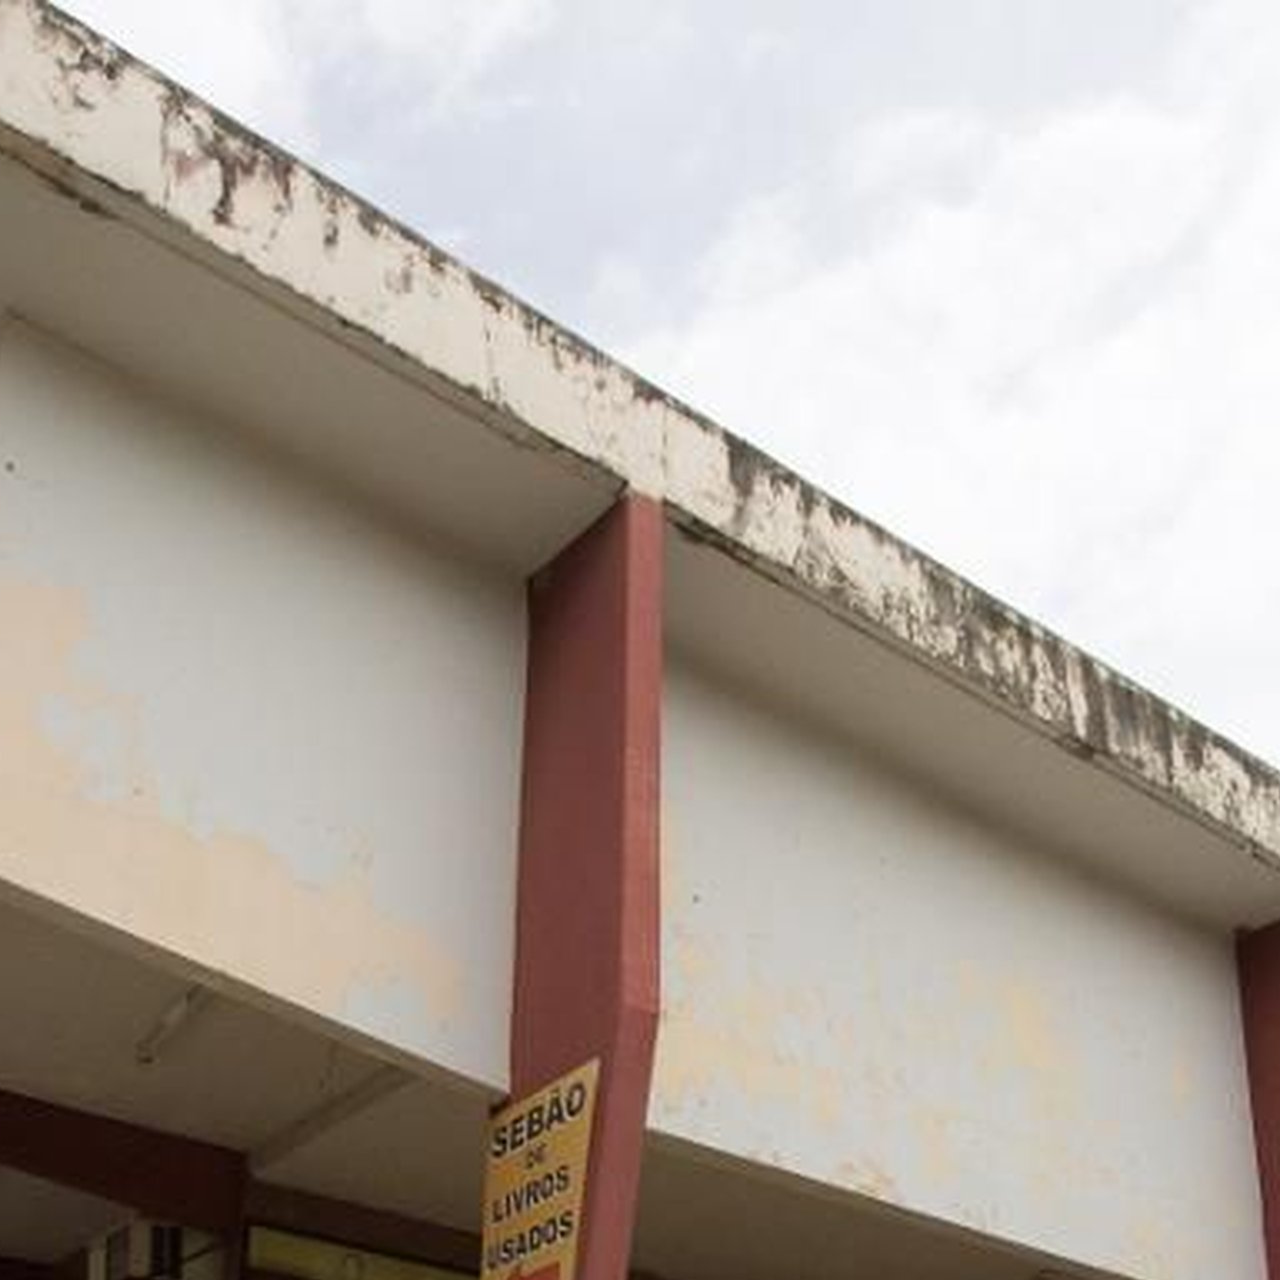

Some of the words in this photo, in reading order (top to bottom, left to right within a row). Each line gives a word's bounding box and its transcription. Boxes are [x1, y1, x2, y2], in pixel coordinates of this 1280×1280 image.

[490, 1080, 587, 1159] SEBÃO
[491, 1164, 570, 1225] LIVROS
[486, 1209, 574, 1273] USADOS
